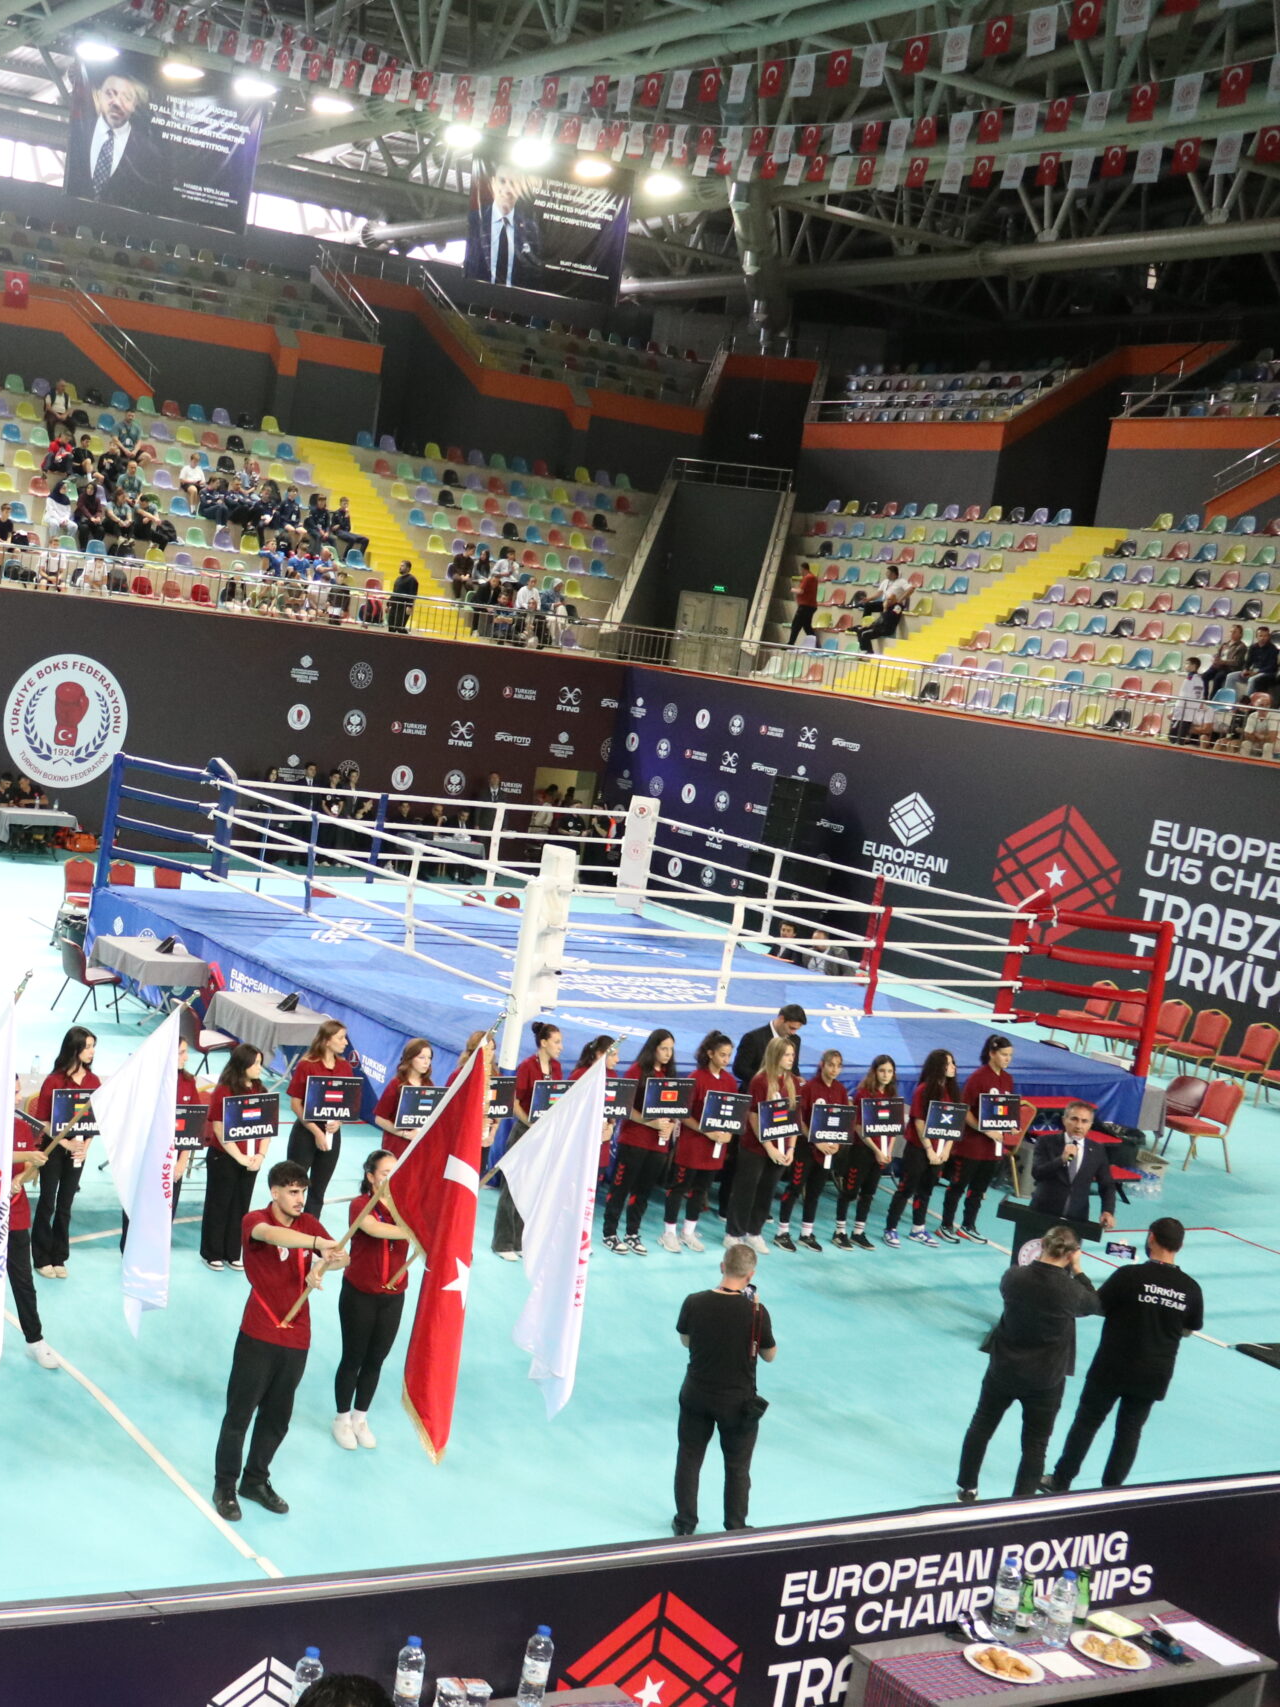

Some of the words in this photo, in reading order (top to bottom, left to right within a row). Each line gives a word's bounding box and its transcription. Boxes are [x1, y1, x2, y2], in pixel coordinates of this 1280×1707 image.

[149, 103, 158, 111] TO
[151, 117, 165, 126] AND
[162, 132, 170, 140] IN
[170, 133, 182, 142] THE
[36, 661, 69, 679] BOKS
[72, 661, 121, 734] FEDERASYONU
[513, 693, 536, 701] AIRLINES
[514, 687, 537, 696] TURKISH
[556, 704, 580, 713] STING
[402, 728, 427, 736] AIRLINES
[403, 722, 428, 730] TURKISH
[448, 738, 473, 748] STING
[494, 731, 531, 746] SPORTOTO
[53, 748, 76, 757] 1924
[20, 751, 42, 775] TURKISH
[42, 772, 69, 782] BOXING
[70, 752, 109, 780] FEDERATION
[500, 781, 523, 789] TURKISH
[1150, 819, 1280, 871] EUROPE
[862, 840, 949, 874] EUROPEAN
[872, 860, 931, 887] BOXING
[1145, 850, 1203, 885] U15
[1139, 888, 1280, 960] TRABZ
[1129, 932, 1280, 1009] TÜRKİY
[230, 968, 269, 993] EUROPEAN
[361, 1054, 387, 1075] TURKISH
[313, 1106, 350, 1118] LATVIA
[604, 1106, 627, 1115] CHIA
[646, 1106, 688, 1115] MONTENEGRO
[401, 1114, 431, 1125] ESTO
[705, 1118, 741, 1129] FINLAND
[982, 1119, 1018, 1129] MOLDOVA
[229, 1124, 274, 1138] CROATIA
[763, 1123, 799, 1137] ARMENIA
[865, 1123, 902, 1133] HUNGARY
[927, 1126, 961, 1138] SCOTLAND
[815, 1130, 848, 1141] GREECE
[161, 1163, 172, 1199] BOKS
[1143, 1283, 1186, 1302] TÜRKİYE
[1138, 1293, 1160, 1306] LOC
[1160, 1297, 1187, 1312] TEAM
[780, 1547, 994, 1607] EUROPEAN
[1000, 1531, 1129, 1573] BOXING
[775, 1607, 844, 1646] U15
